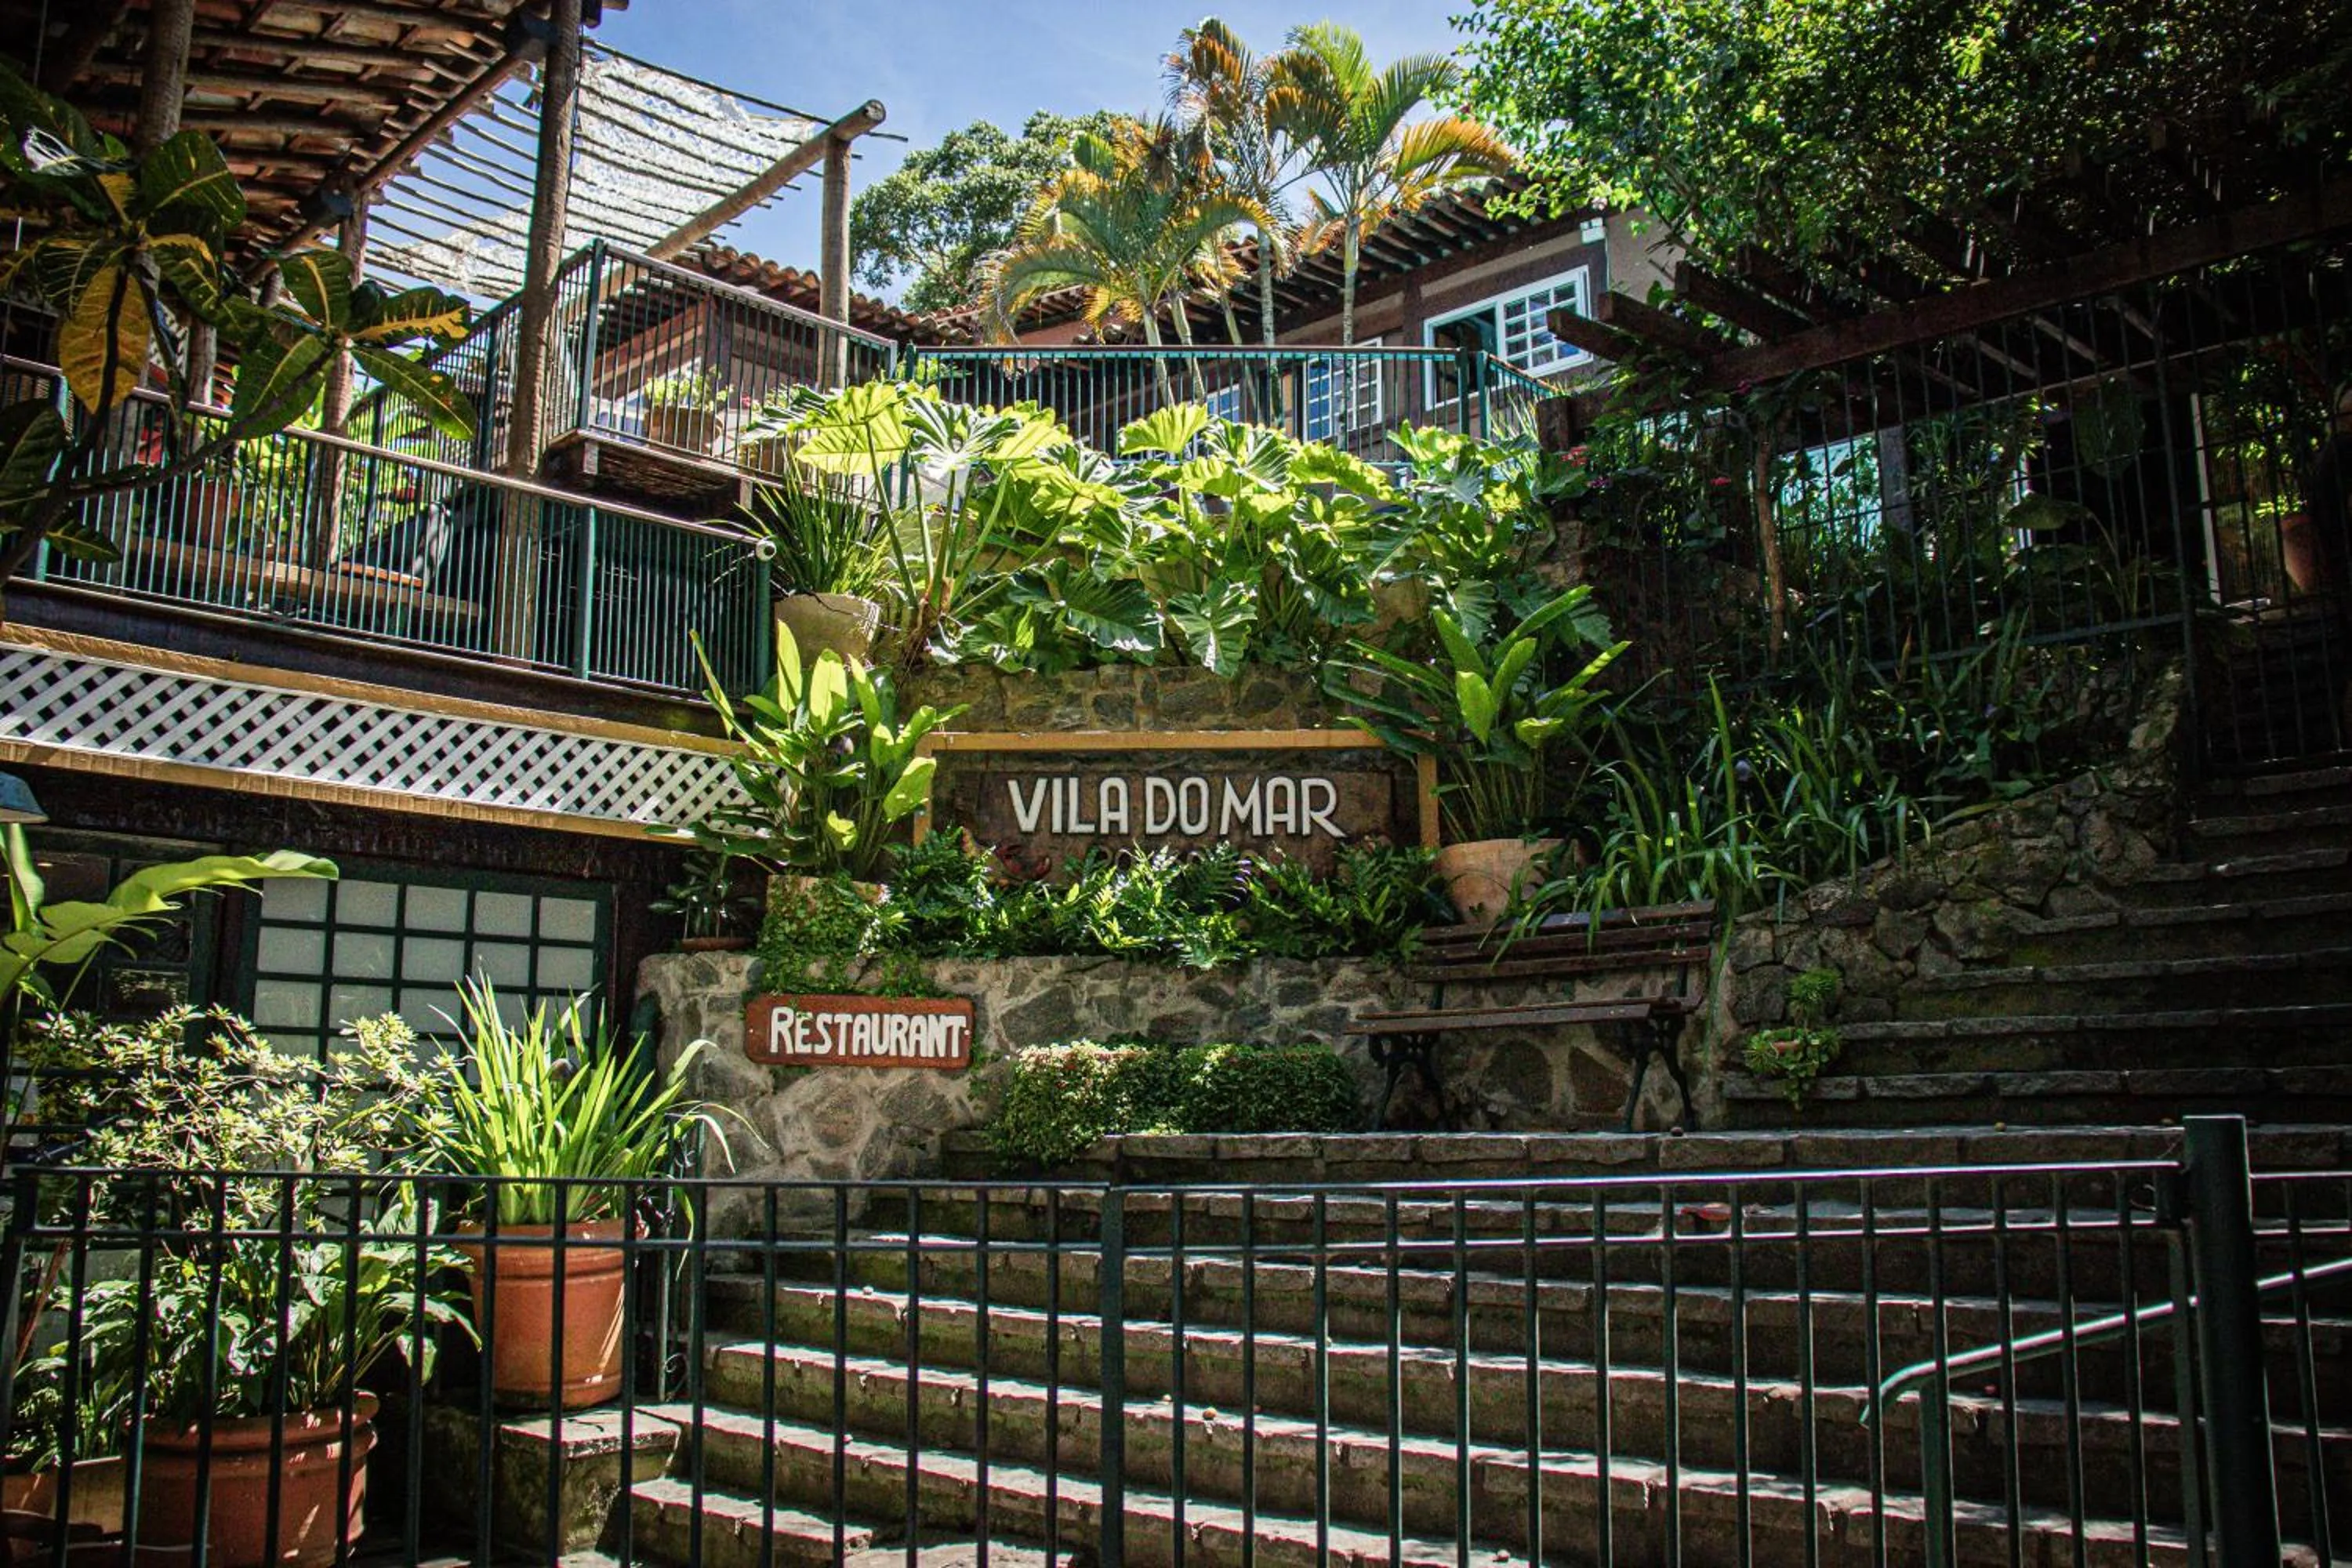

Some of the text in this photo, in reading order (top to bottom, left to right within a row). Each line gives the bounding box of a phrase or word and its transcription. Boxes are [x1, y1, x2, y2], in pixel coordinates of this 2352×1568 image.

[1007, 776, 1347, 837] VILA DO MAR
[769, 1006, 967, 1058] RESTAURANT
